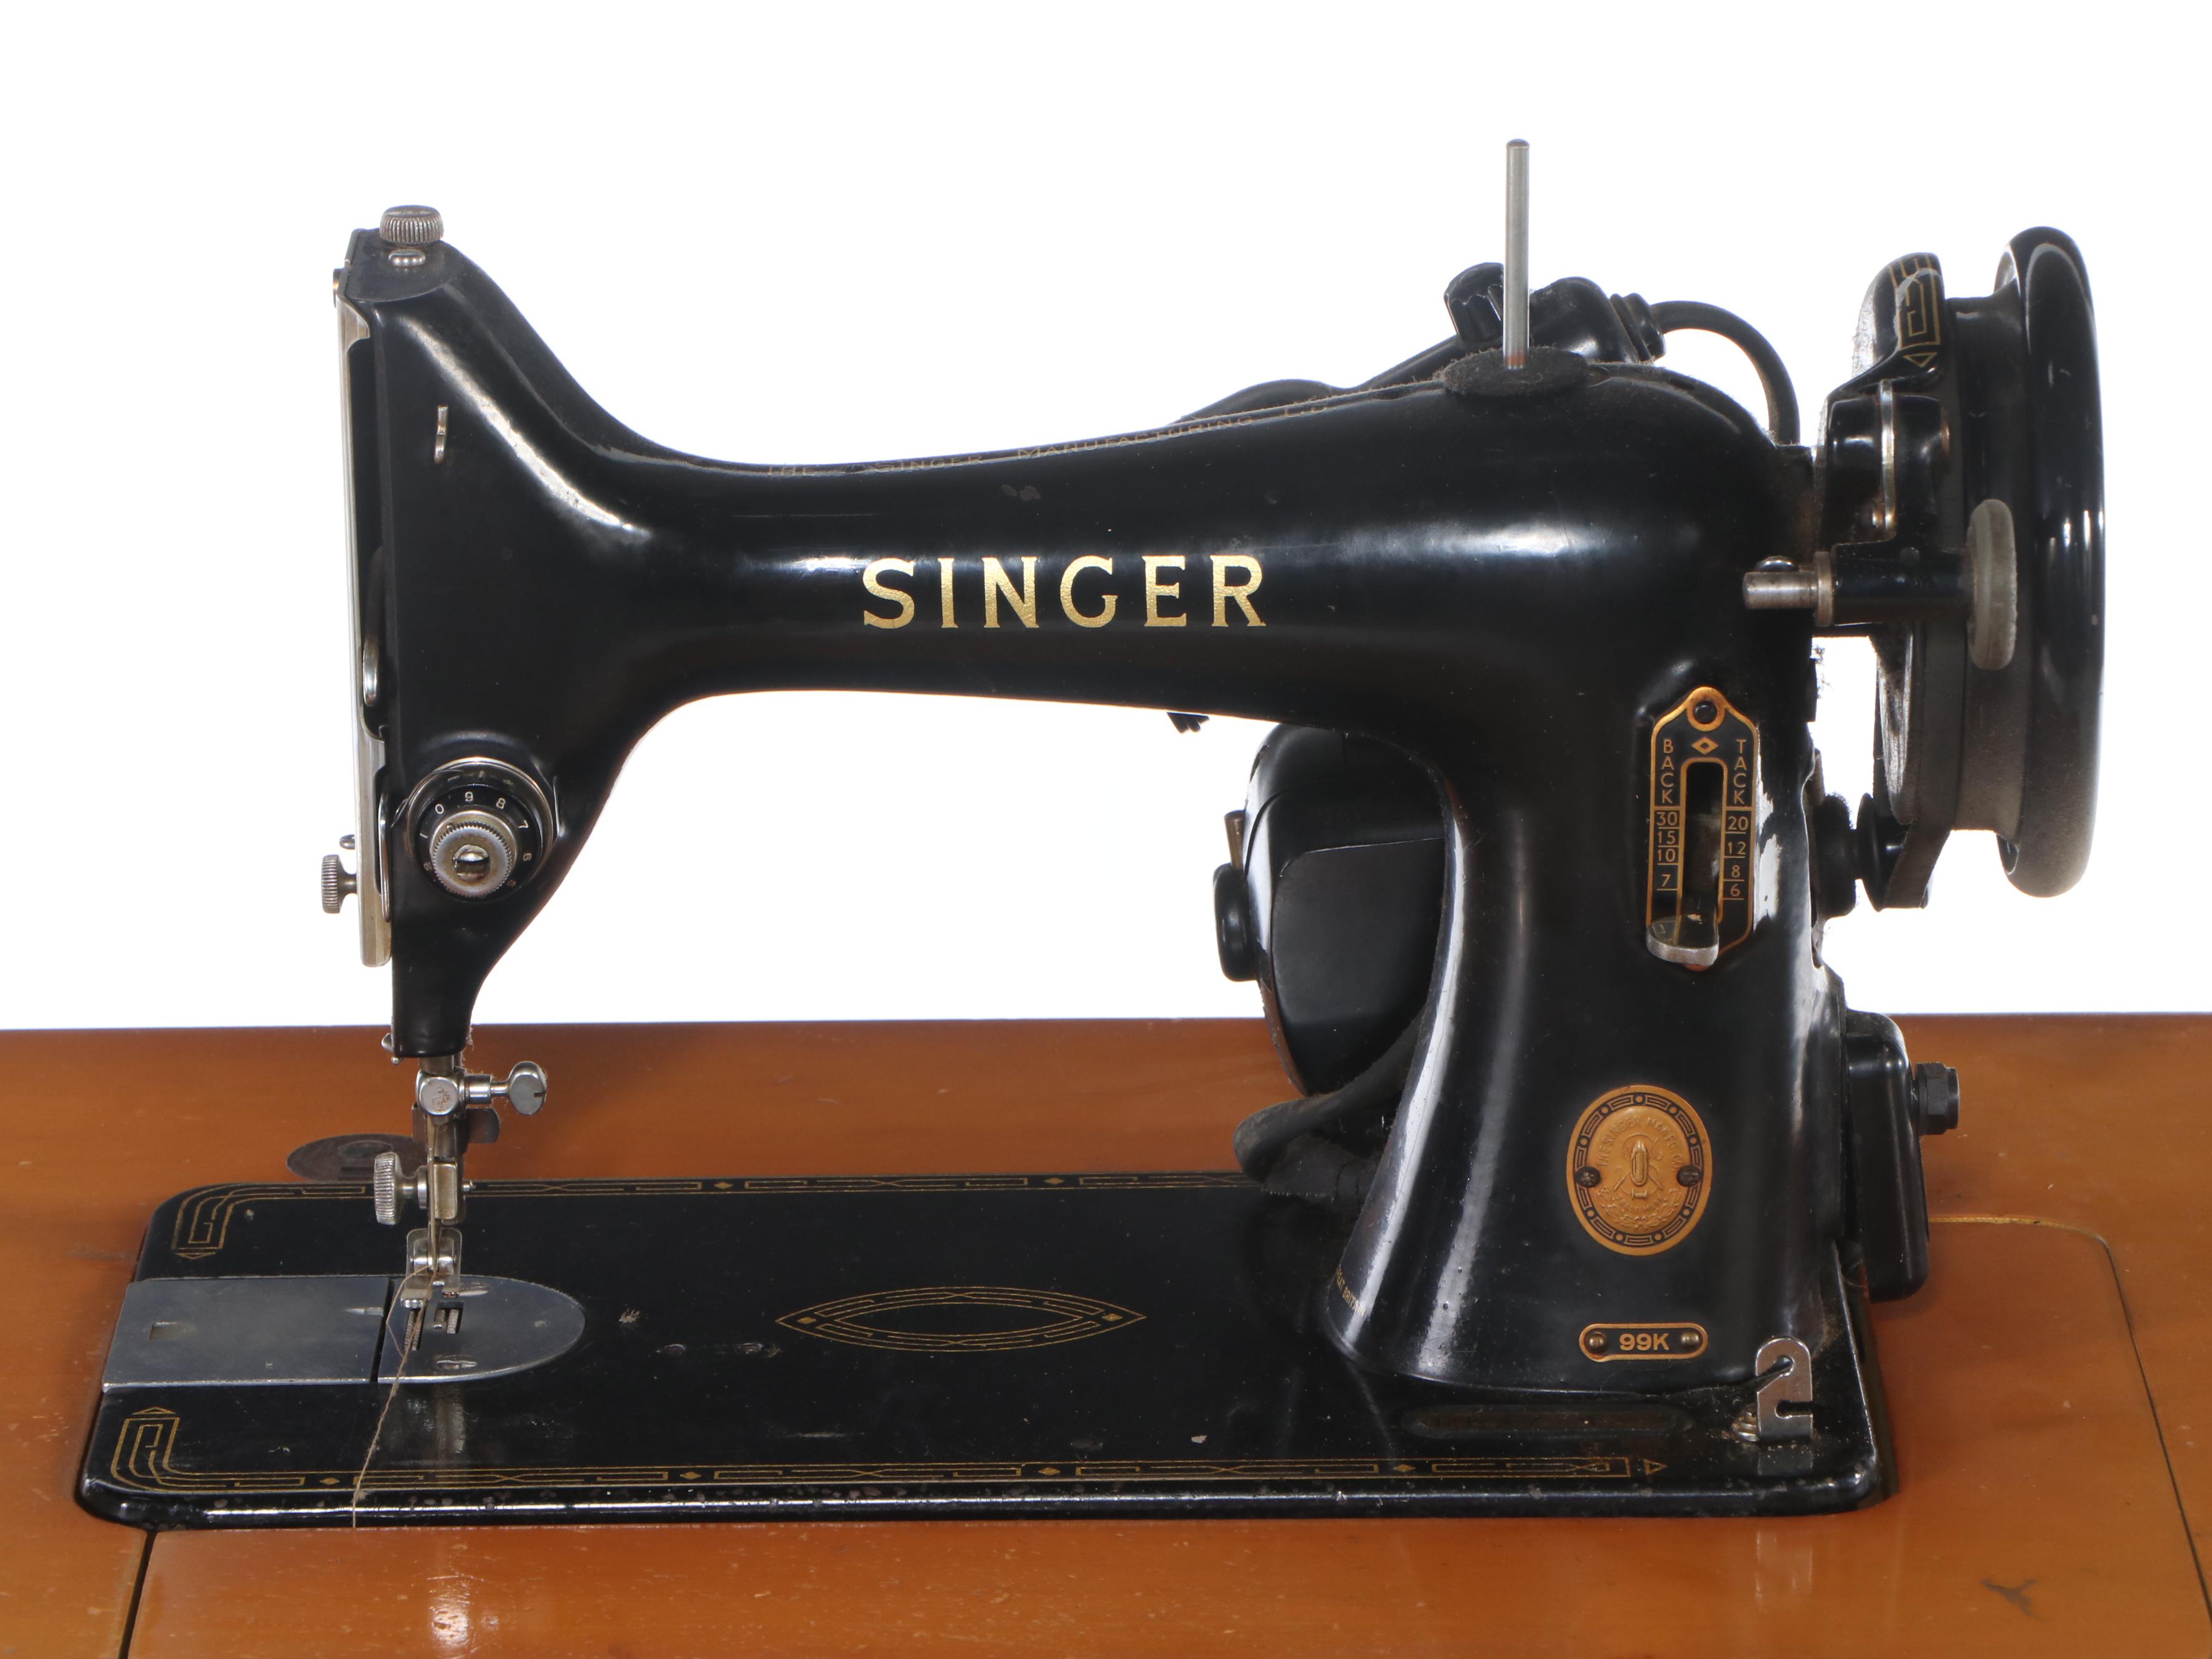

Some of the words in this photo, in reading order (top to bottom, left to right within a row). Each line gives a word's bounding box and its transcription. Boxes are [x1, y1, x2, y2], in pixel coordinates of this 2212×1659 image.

[862, 554, 1267, 629] SINGER
[1660, 739, 1675, 805] BACK
[1732, 739, 1747, 805] TACK
[465, 792, 473, 802] 9
[496, 798, 506, 809] 8
[435, 803, 445, 815] 0
[519, 820, 529, 829] 7
[1656, 811, 1678, 826] 30
[1728, 816, 1749, 831] 20
[1657, 830, 1676, 845] 15
[1657, 848, 1676, 863] 10
[1728, 841, 1746, 856] 12
[523, 853, 532, 861] 6
[1731, 865, 1741, 877] 8
[1661, 874, 1671, 887] 7
[1730, 884, 1740, 897] 6
[1619, 1333, 1670, 1351] 99K
